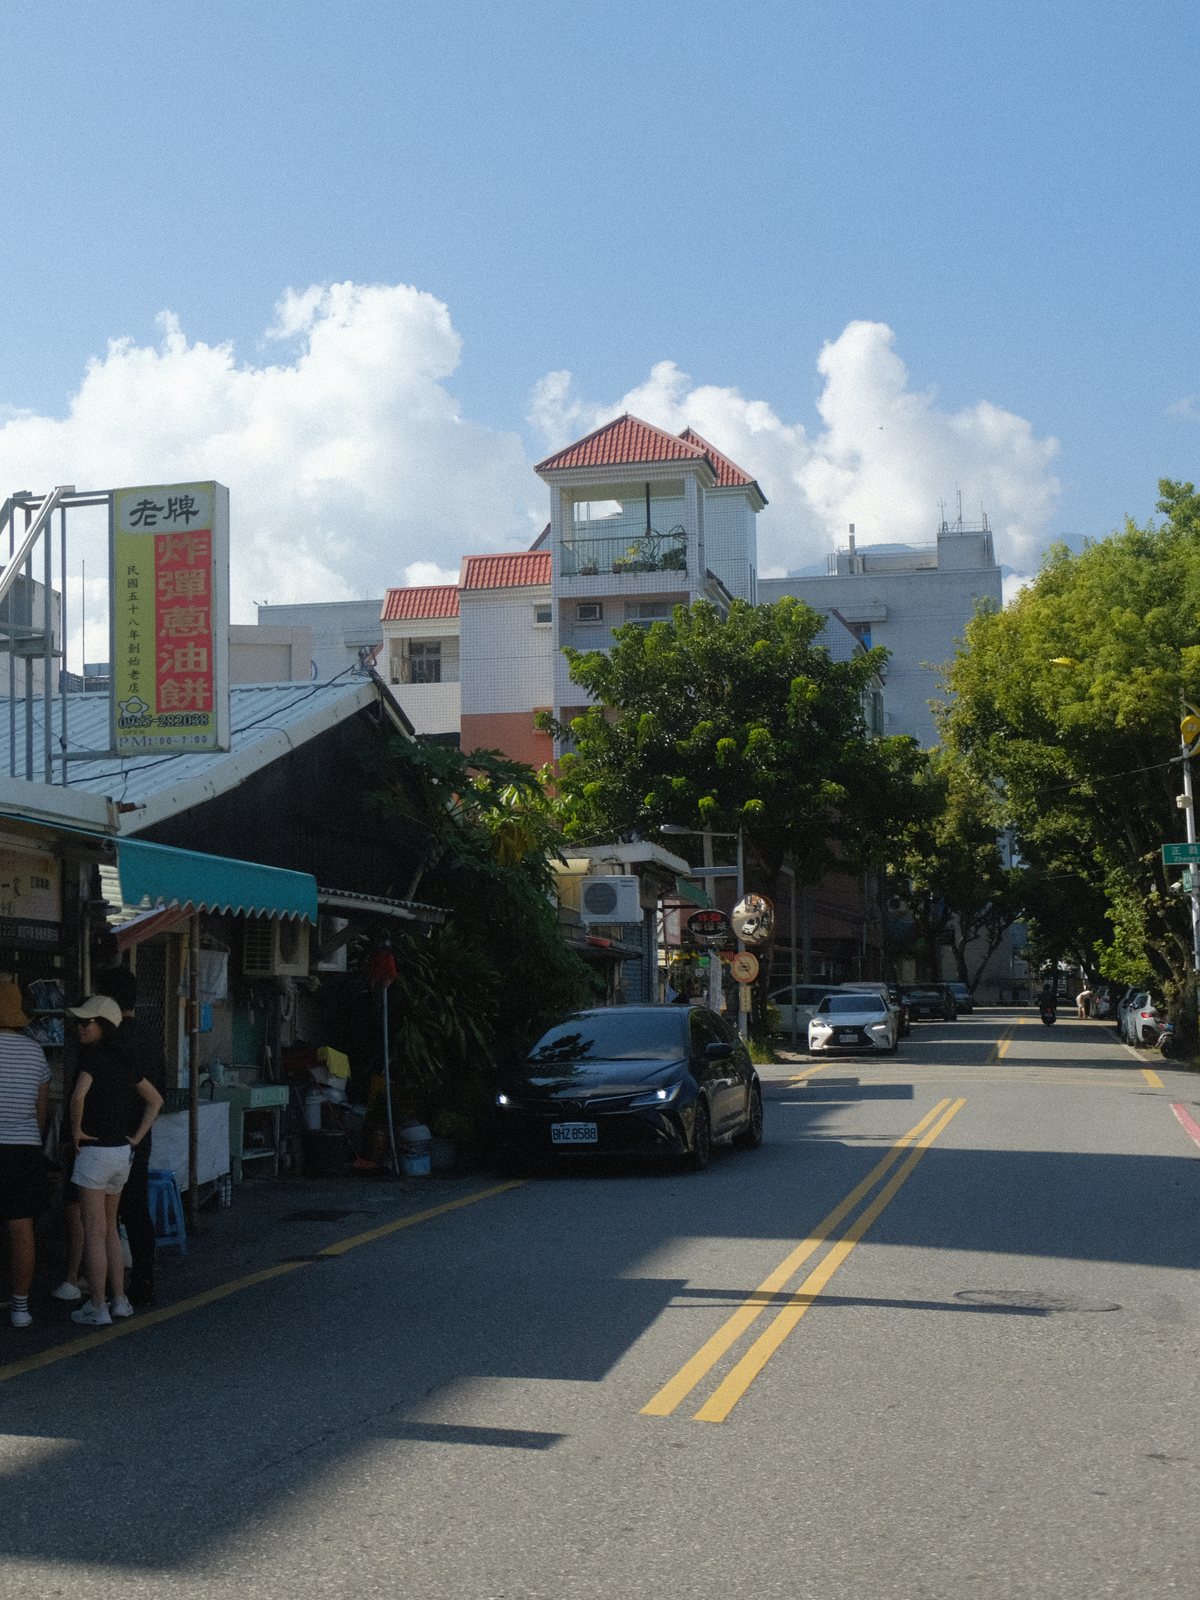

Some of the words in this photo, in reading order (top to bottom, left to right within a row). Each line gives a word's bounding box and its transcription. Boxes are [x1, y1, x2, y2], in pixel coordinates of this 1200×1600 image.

[129, 495, 201, 528] 老牌
[126, 565, 141, 694] 民國五十八年創始老店
[157, 533, 210, 710] 炸彈蔥油餅
[117, 713, 210, 729] 0955-282038
